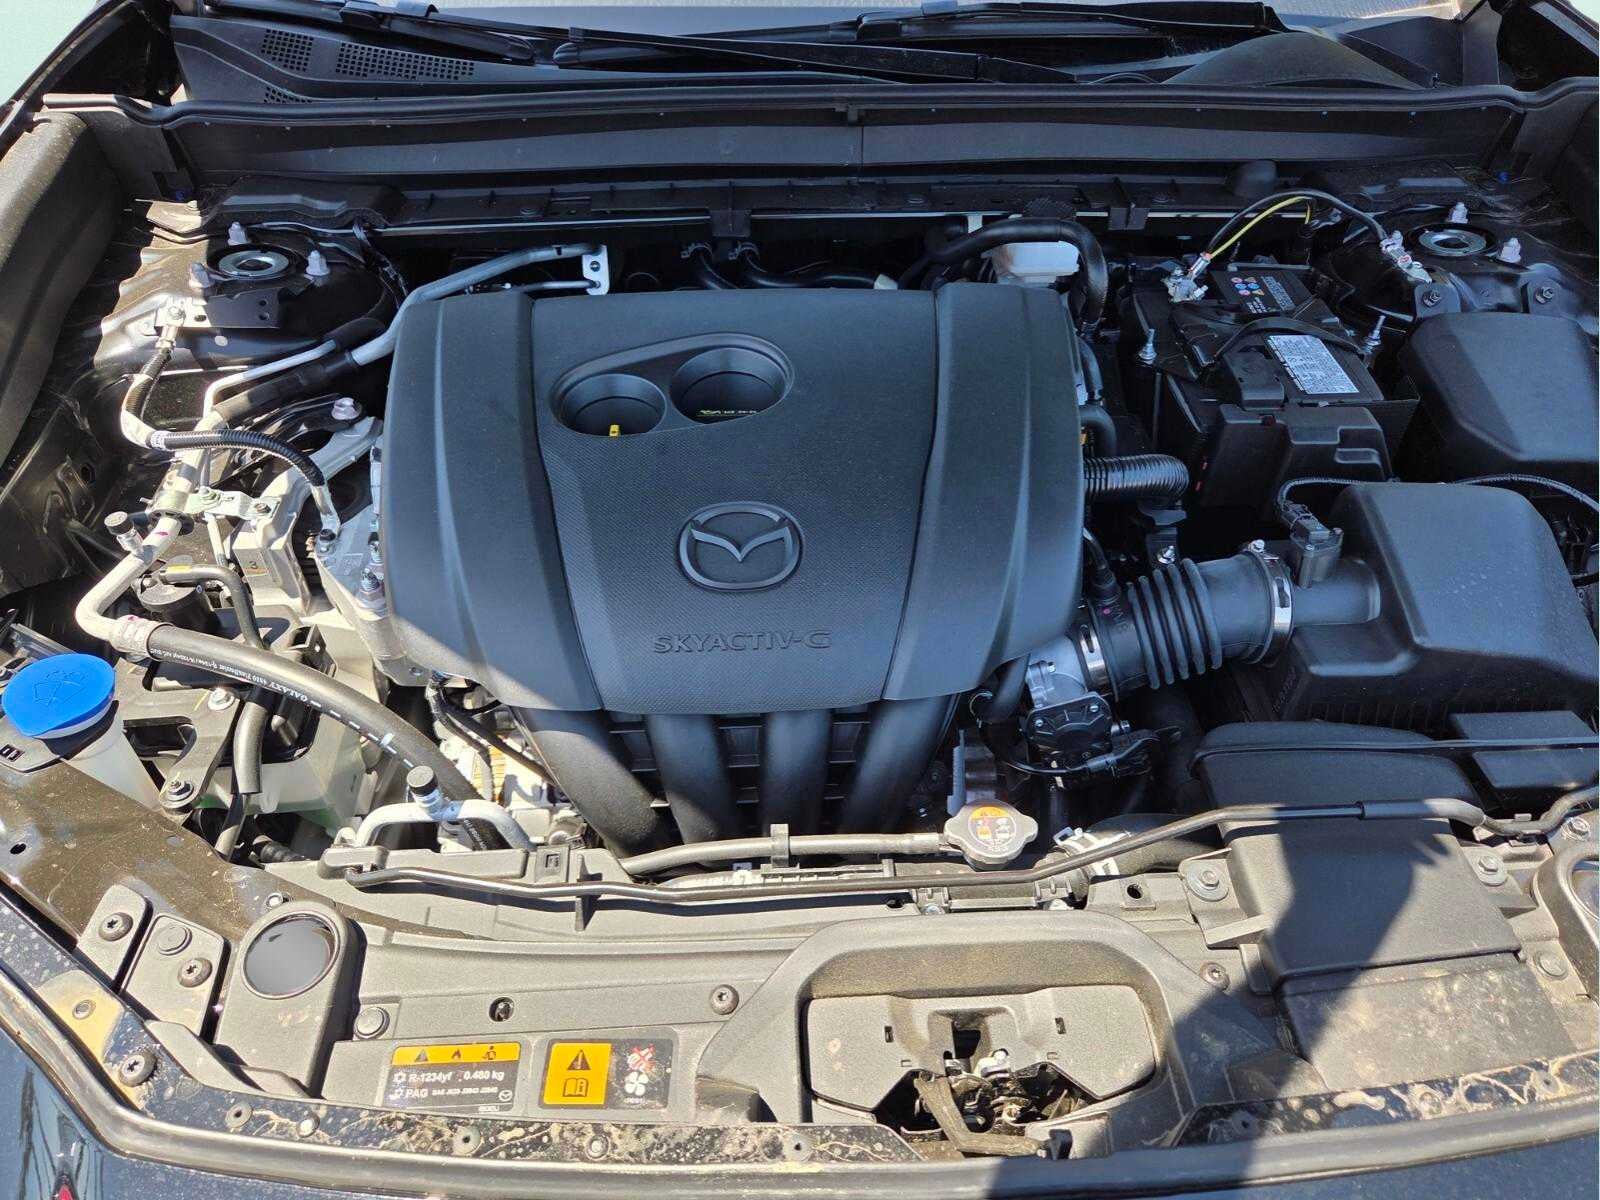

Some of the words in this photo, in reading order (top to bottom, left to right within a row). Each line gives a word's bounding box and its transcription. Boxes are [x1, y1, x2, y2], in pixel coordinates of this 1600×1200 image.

[653, 630, 832, 654] SKYACTIV-G
[268, 681, 308, 703] GALAXY
[492, 1069, 505, 1082] kg
[405, 1087, 429, 1098] PAG
